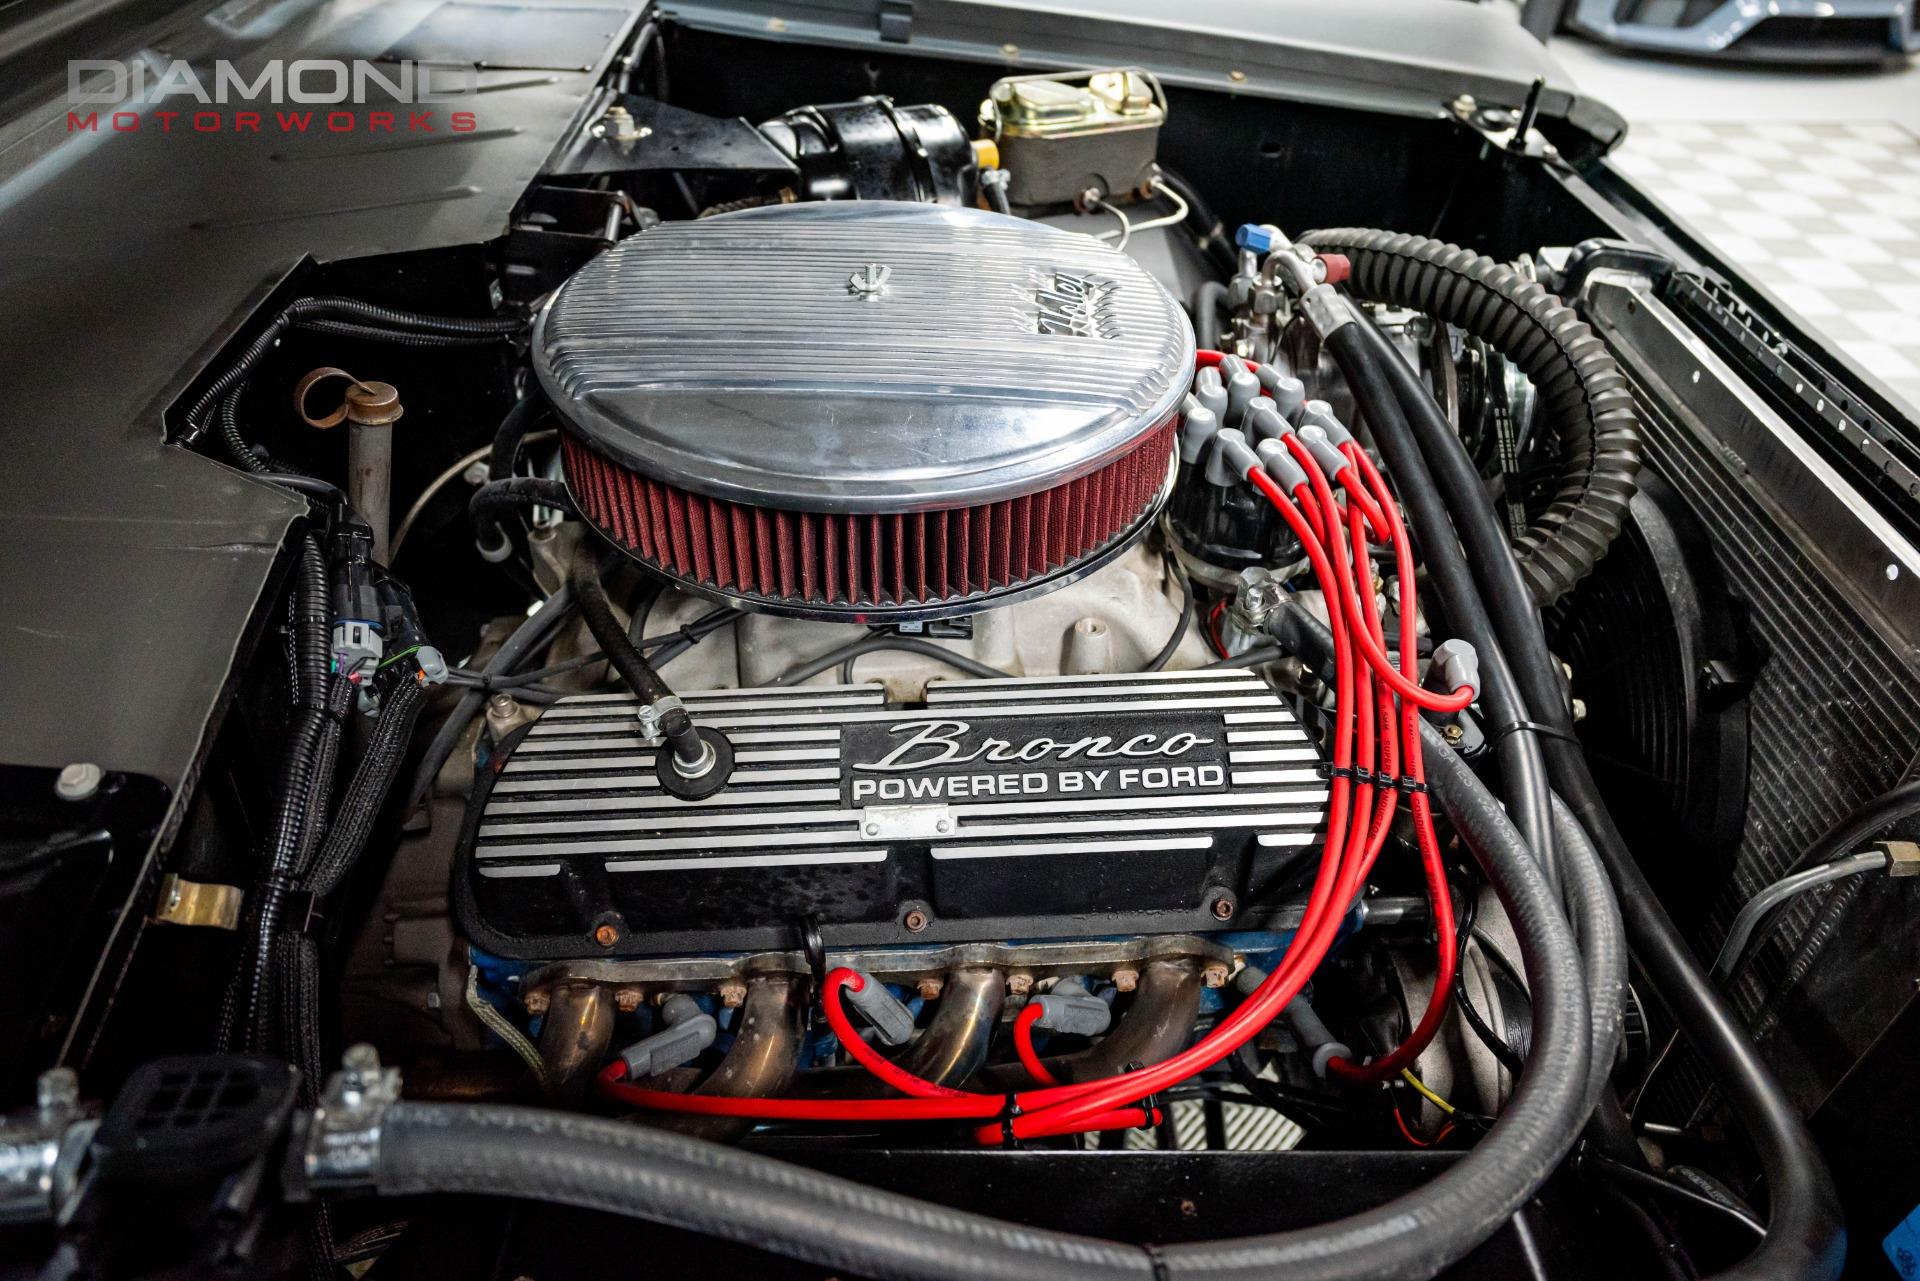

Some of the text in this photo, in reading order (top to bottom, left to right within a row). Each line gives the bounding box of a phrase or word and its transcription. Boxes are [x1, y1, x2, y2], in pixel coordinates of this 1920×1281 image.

[852, 720, 1214, 771] Bronco
[853, 765, 1224, 801] POWERED BY FORD
